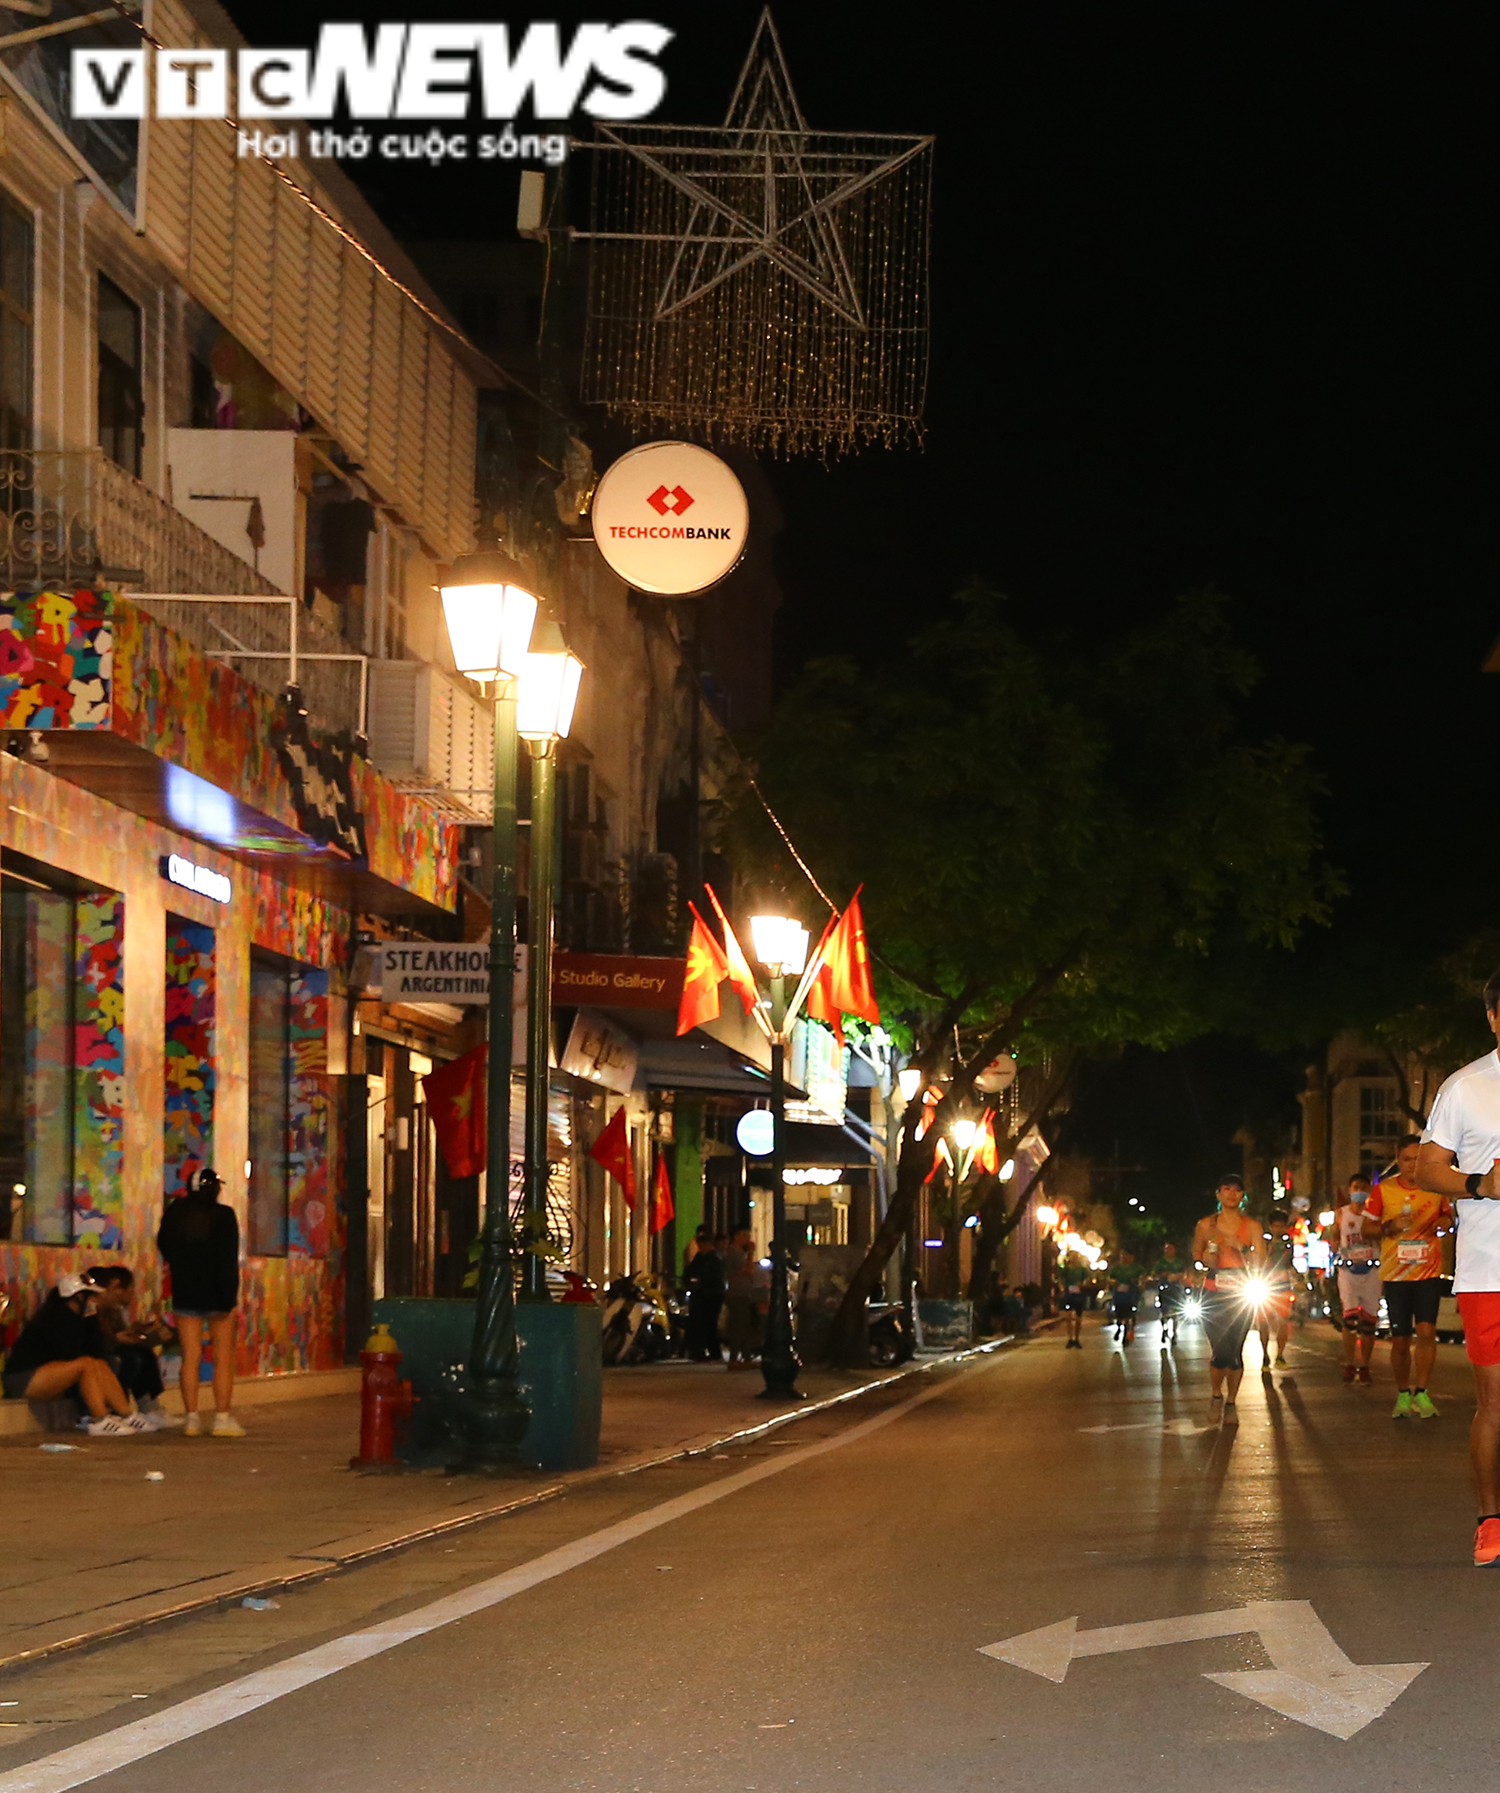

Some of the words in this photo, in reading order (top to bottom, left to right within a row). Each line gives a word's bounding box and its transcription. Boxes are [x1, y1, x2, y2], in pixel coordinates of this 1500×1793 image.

[610, 526, 731, 540] TECHCOMBANK
[400, 976, 490, 994] ARGENTINI
[560, 969, 608, 986] Studio
[613, 973, 666, 992] Gallery
